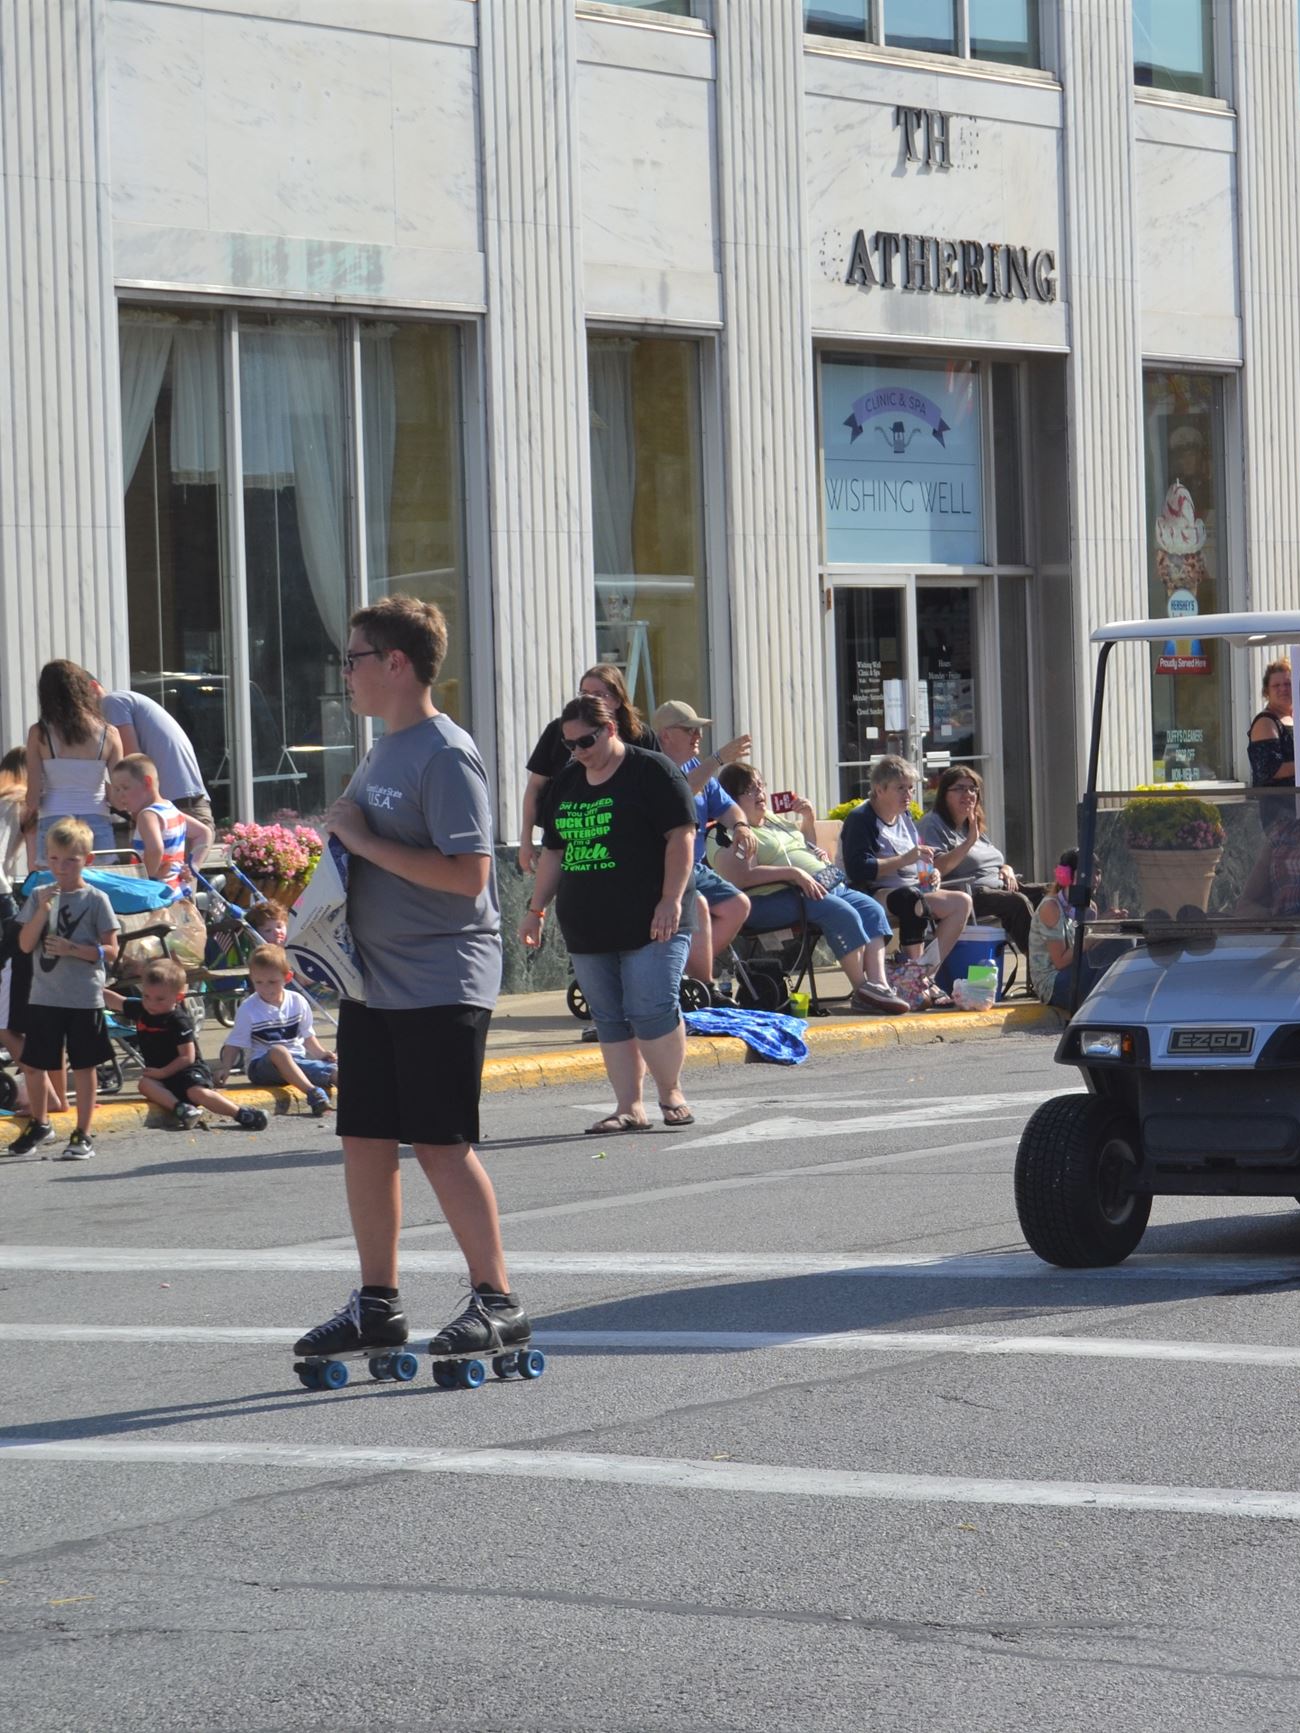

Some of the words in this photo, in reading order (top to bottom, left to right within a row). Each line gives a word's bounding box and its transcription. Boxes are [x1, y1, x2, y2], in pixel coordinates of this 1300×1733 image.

[845, 229, 1057, 303] ATHERING
[865, 392, 897, 413] CLINIC
[899, 395, 906, 408] &
[908, 396, 927, 415] SPA
[825, 478, 915, 513] WISHING
[919, 481, 972, 515] WELL
[1160, 658, 1178, 671] Proudly
[1178, 658, 1195, 668] Served
[585, 815, 596, 827] IT
[597, 812, 613, 825] UP
[600, 861, 616, 869] DO
